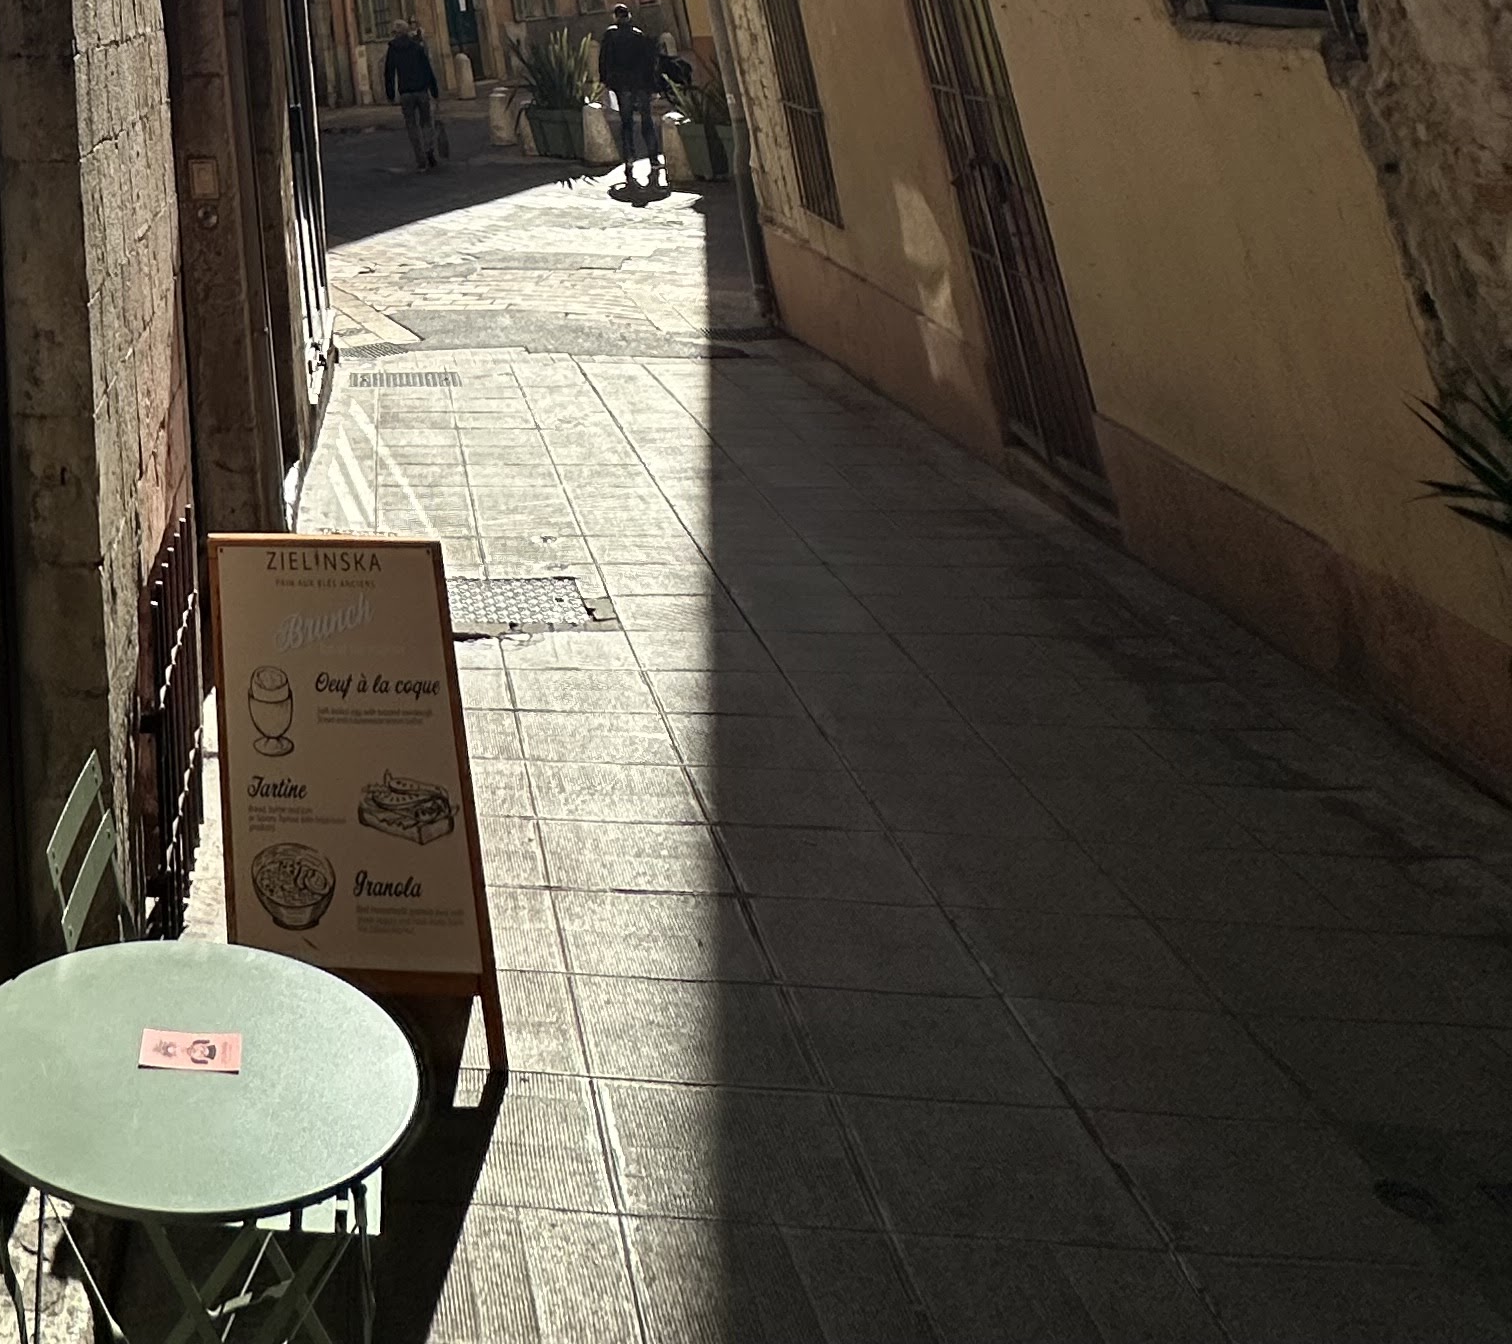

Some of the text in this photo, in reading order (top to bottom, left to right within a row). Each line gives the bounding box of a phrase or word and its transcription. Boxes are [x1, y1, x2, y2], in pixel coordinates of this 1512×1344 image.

[266, 549, 383, 573] ZIELINSKA
[273, 591, 376, 654] Brunch
[314, 671, 441, 700] Oeuf à la coque
[246, 774, 308, 800] Tartine
[352, 869, 423, 899] Granola
